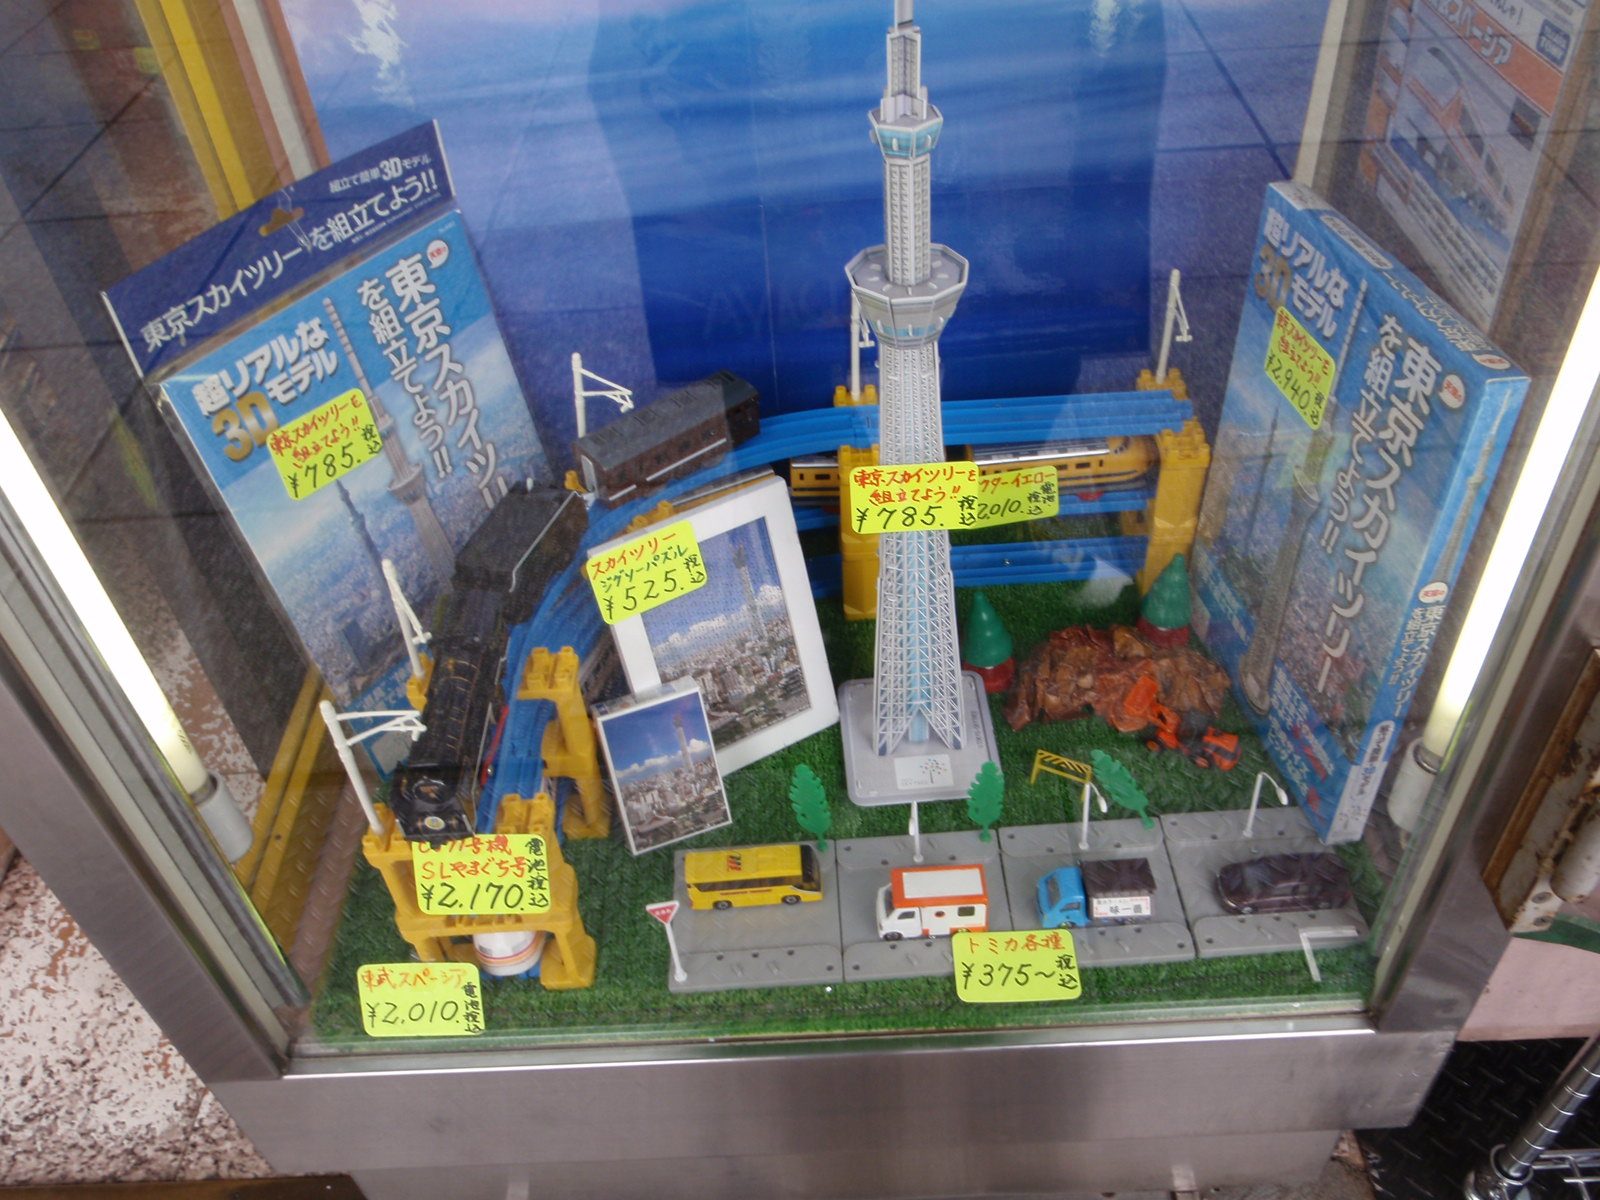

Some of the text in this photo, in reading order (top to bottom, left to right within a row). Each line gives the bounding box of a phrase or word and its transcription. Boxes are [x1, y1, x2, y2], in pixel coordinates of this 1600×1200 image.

[1264, 208, 1349, 309] 超リアルな
[192, 316, 330, 418] 超リアルな
[958, 495, 978, 526] 税込
[1317, 337, 1442, 693] 東京スカイツリー
[591, 532, 677, 579] スカイツリー
[600, 545, 688, 593] ジグソーパズル
[683, 554, 705, 584] 税込
[421, 857, 527, 880] SLやまぐち号
[968, 932, 1065, 954] トミカ各種
[361, 967, 467, 992] 東武スペーシア
[1056, 954, 1079, 990] 税込
